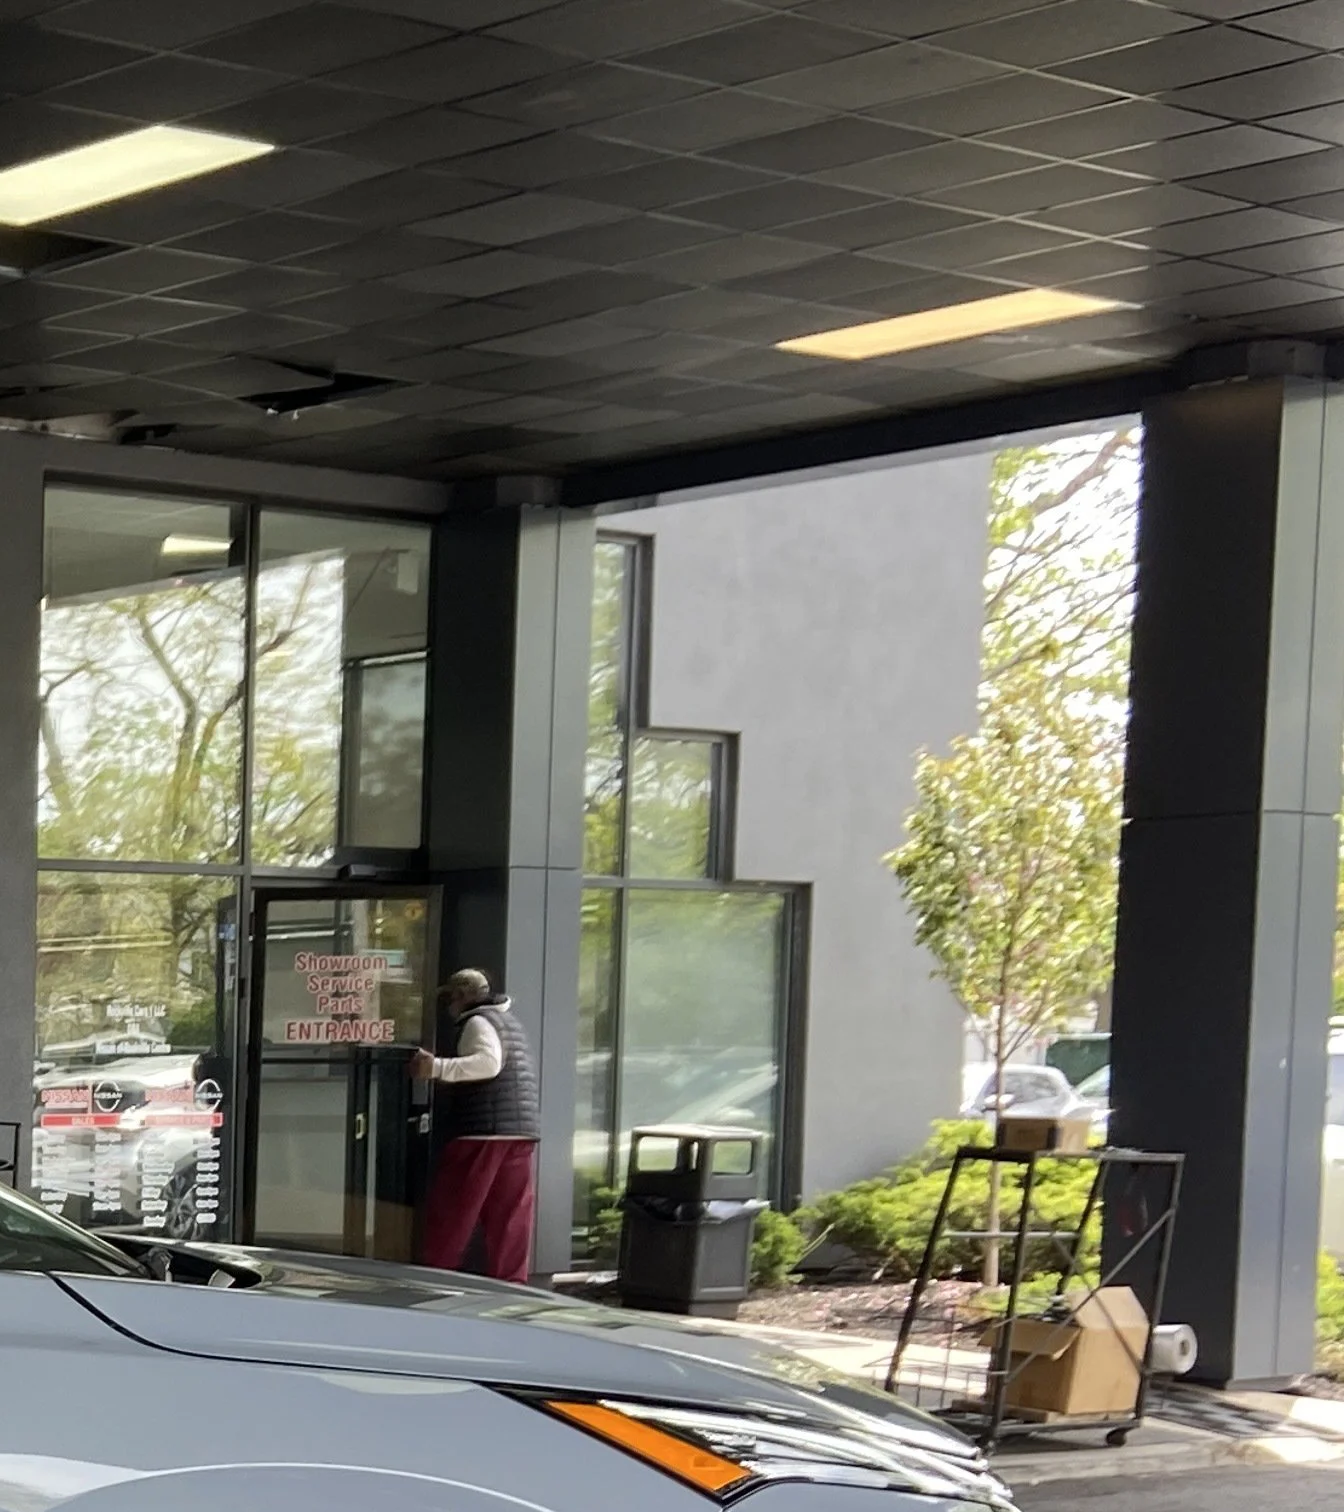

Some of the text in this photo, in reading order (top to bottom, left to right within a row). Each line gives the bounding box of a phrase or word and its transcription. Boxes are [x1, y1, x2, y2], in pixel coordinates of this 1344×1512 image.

[295, 952, 389, 972] Showroom
[308, 974, 375, 992] Service
[318, 995, 363, 1013] Parts
[286, 1021, 394, 1041] ENTRANCE
